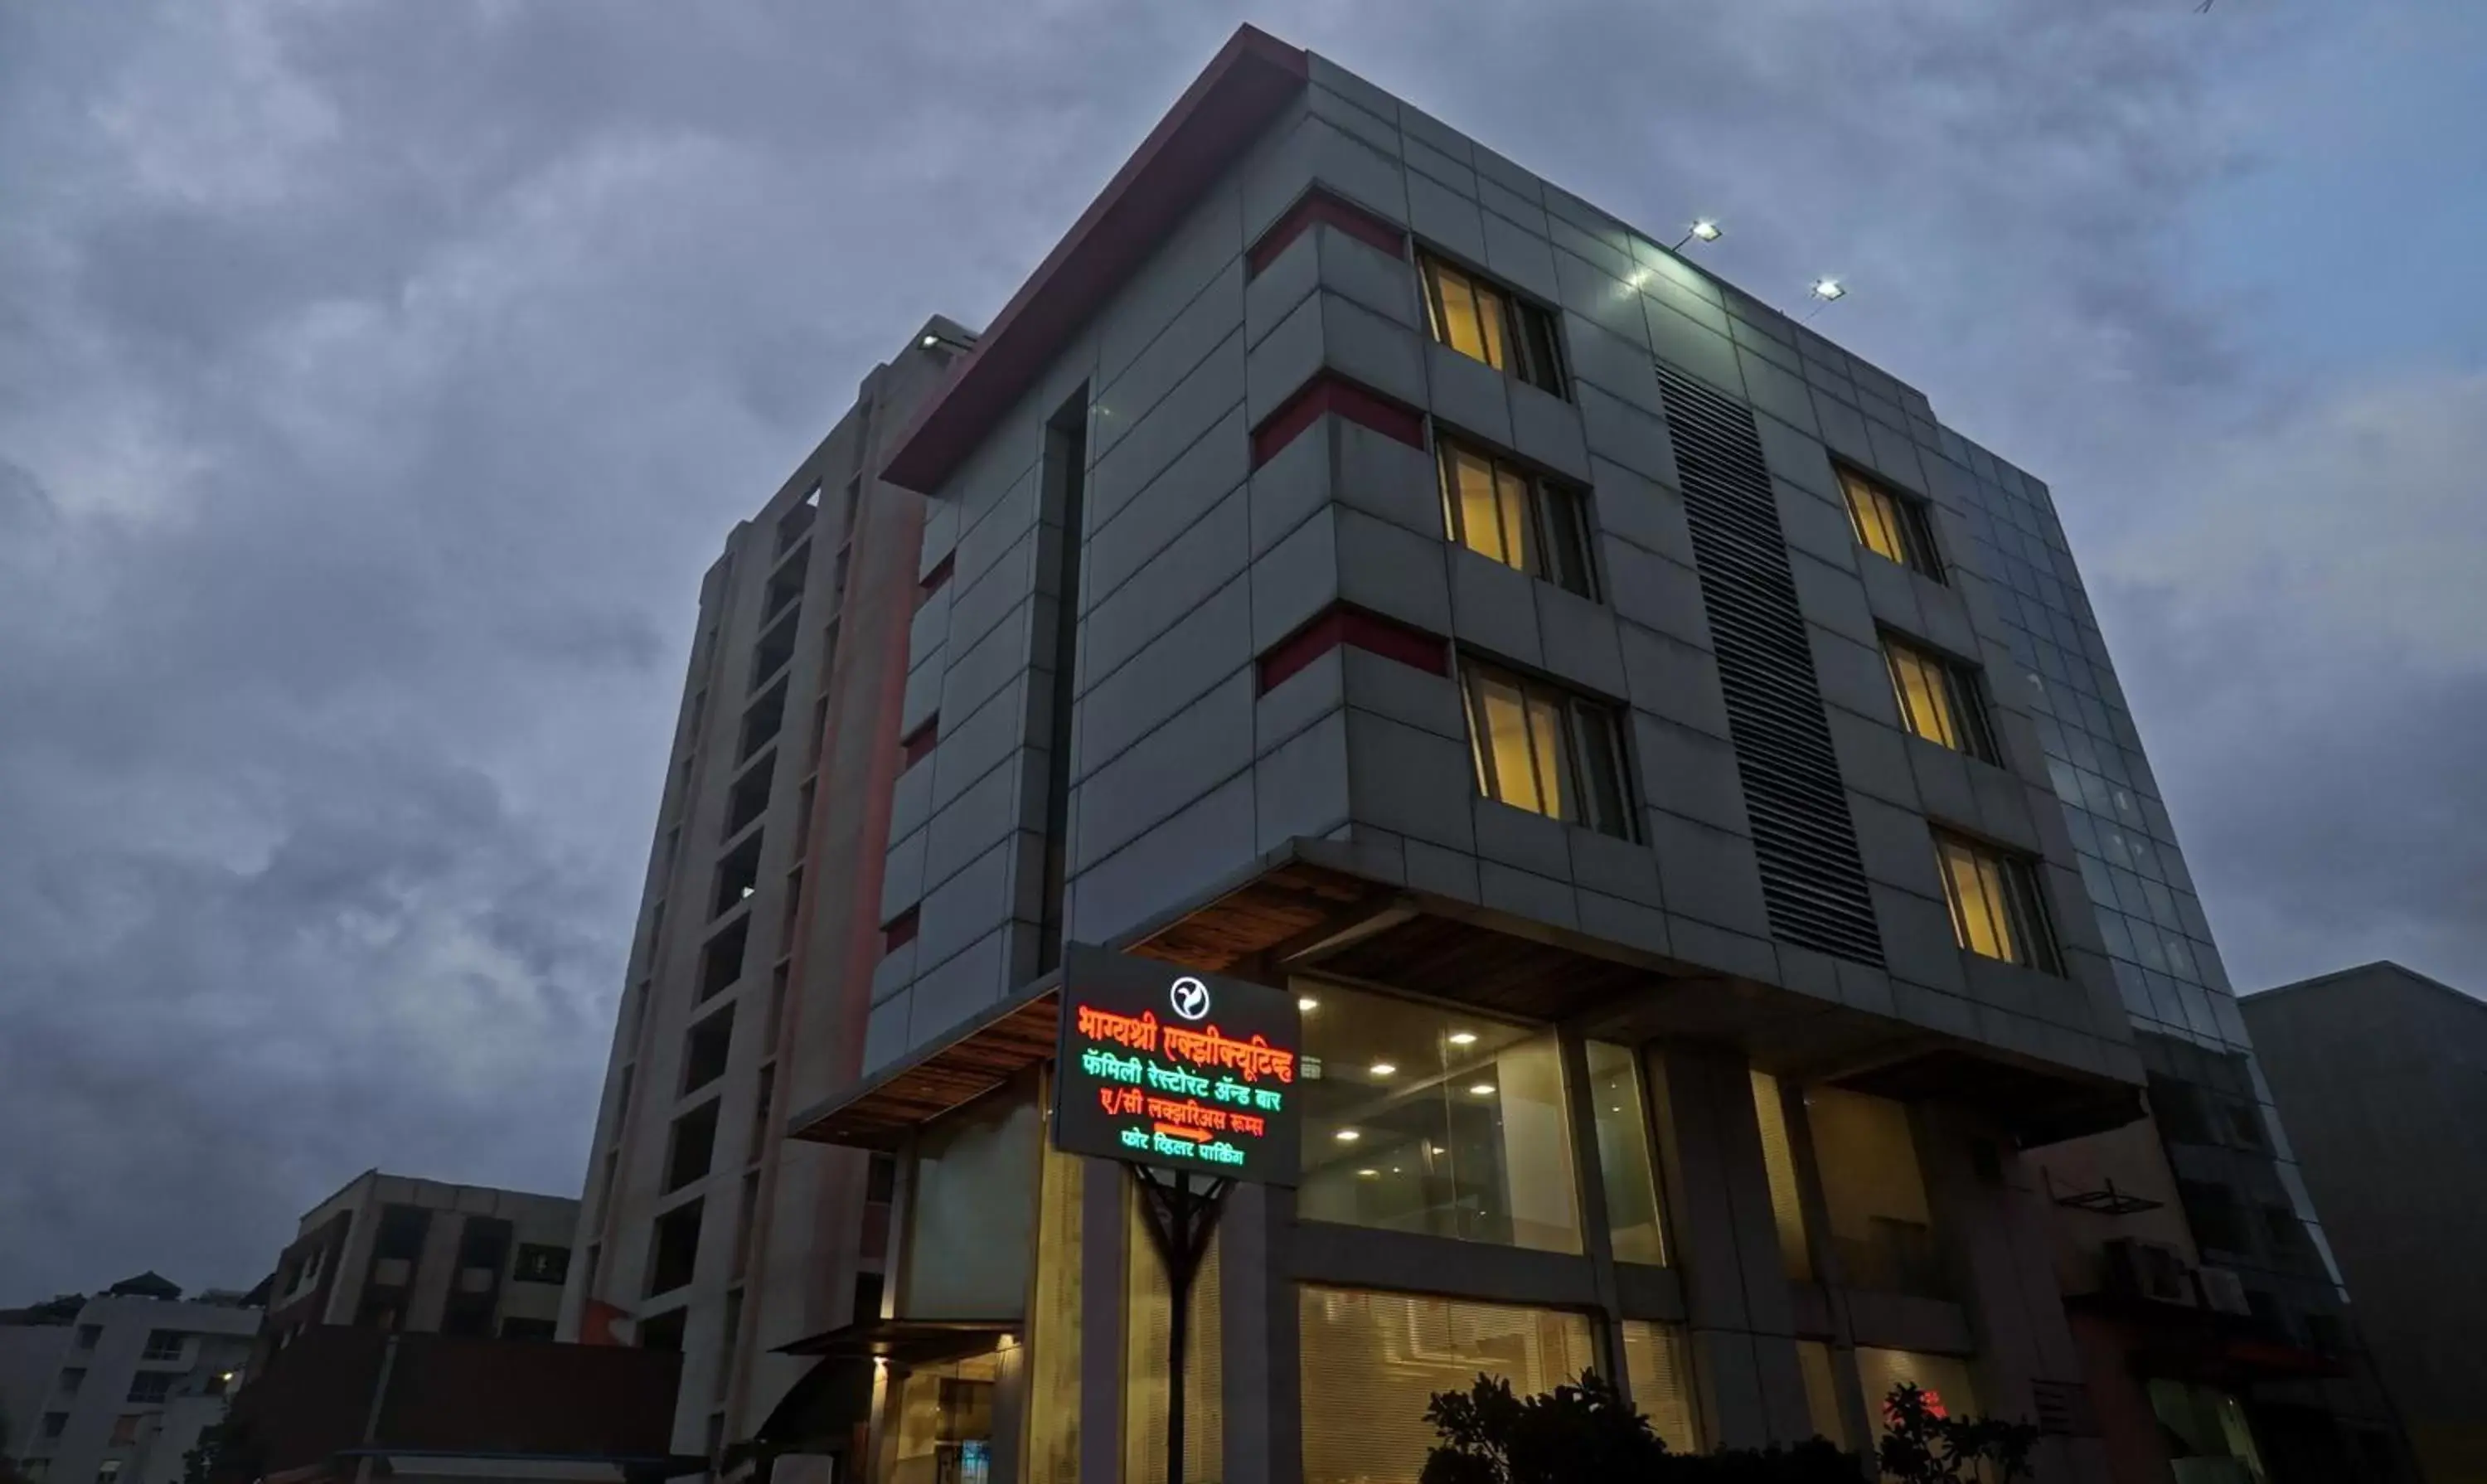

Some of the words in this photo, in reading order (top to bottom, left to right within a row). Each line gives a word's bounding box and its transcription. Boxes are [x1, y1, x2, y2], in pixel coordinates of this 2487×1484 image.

[1079, 1006, 1157, 1051] भाग्यश्री
[1082, 1048, 1142, 1084] फॅमिली
[1147, 1060, 1209, 1097] रेस्टोरंट
[1255, 1089, 1282, 1111] बार
[1101, 1088, 1143, 1114] ए/सी
[1122, 1128, 1149, 1149] फोर
[1154, 1132, 1195, 1157] व्हिलर
